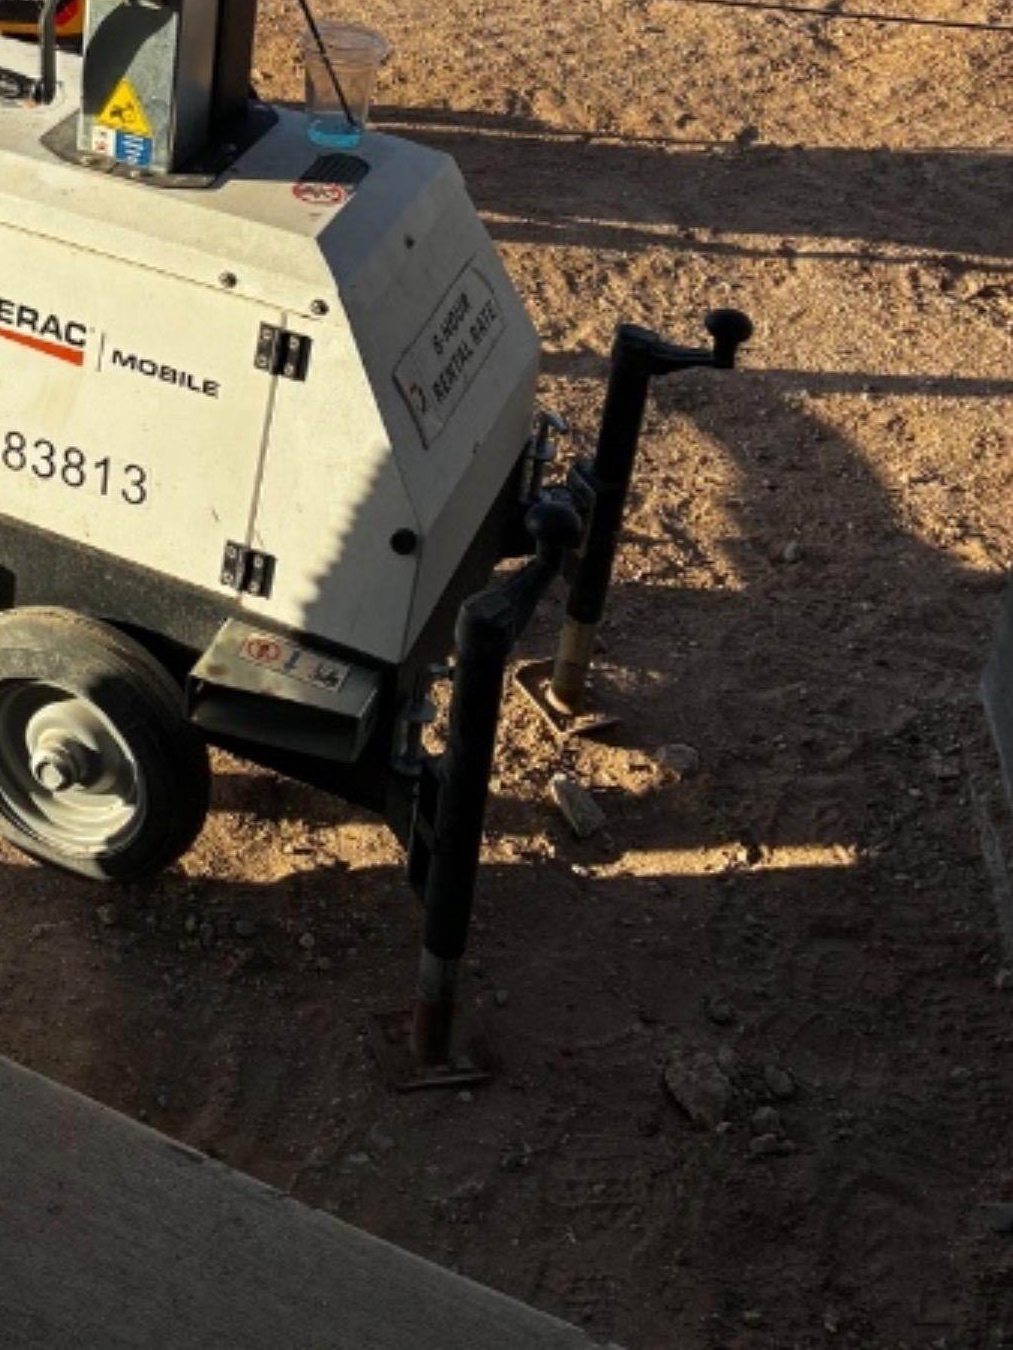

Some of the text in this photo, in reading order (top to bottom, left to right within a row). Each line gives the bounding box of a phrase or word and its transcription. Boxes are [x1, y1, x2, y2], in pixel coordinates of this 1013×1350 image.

[111, 349, 221, 398] MOBILE
[432, 300, 498, 402] RENTAL RATE
